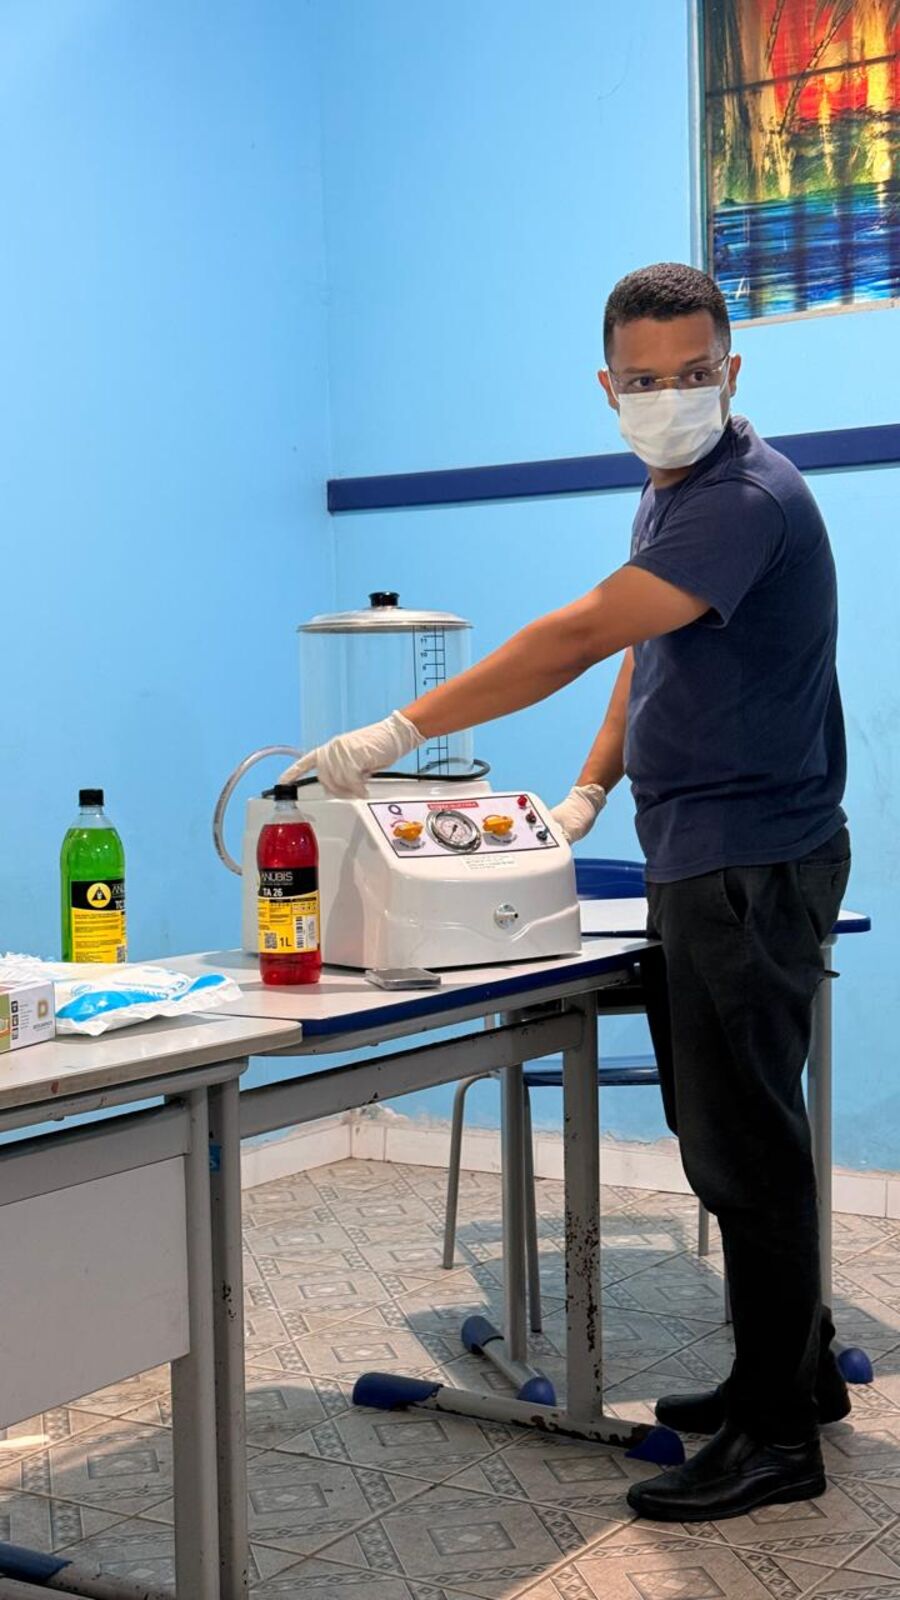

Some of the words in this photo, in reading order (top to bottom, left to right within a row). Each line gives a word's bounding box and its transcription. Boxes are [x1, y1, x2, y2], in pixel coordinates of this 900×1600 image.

[263, 888, 272, 897] TA
[273, 888, 283, 897] 26
[280, 936, 292, 947] 1L
